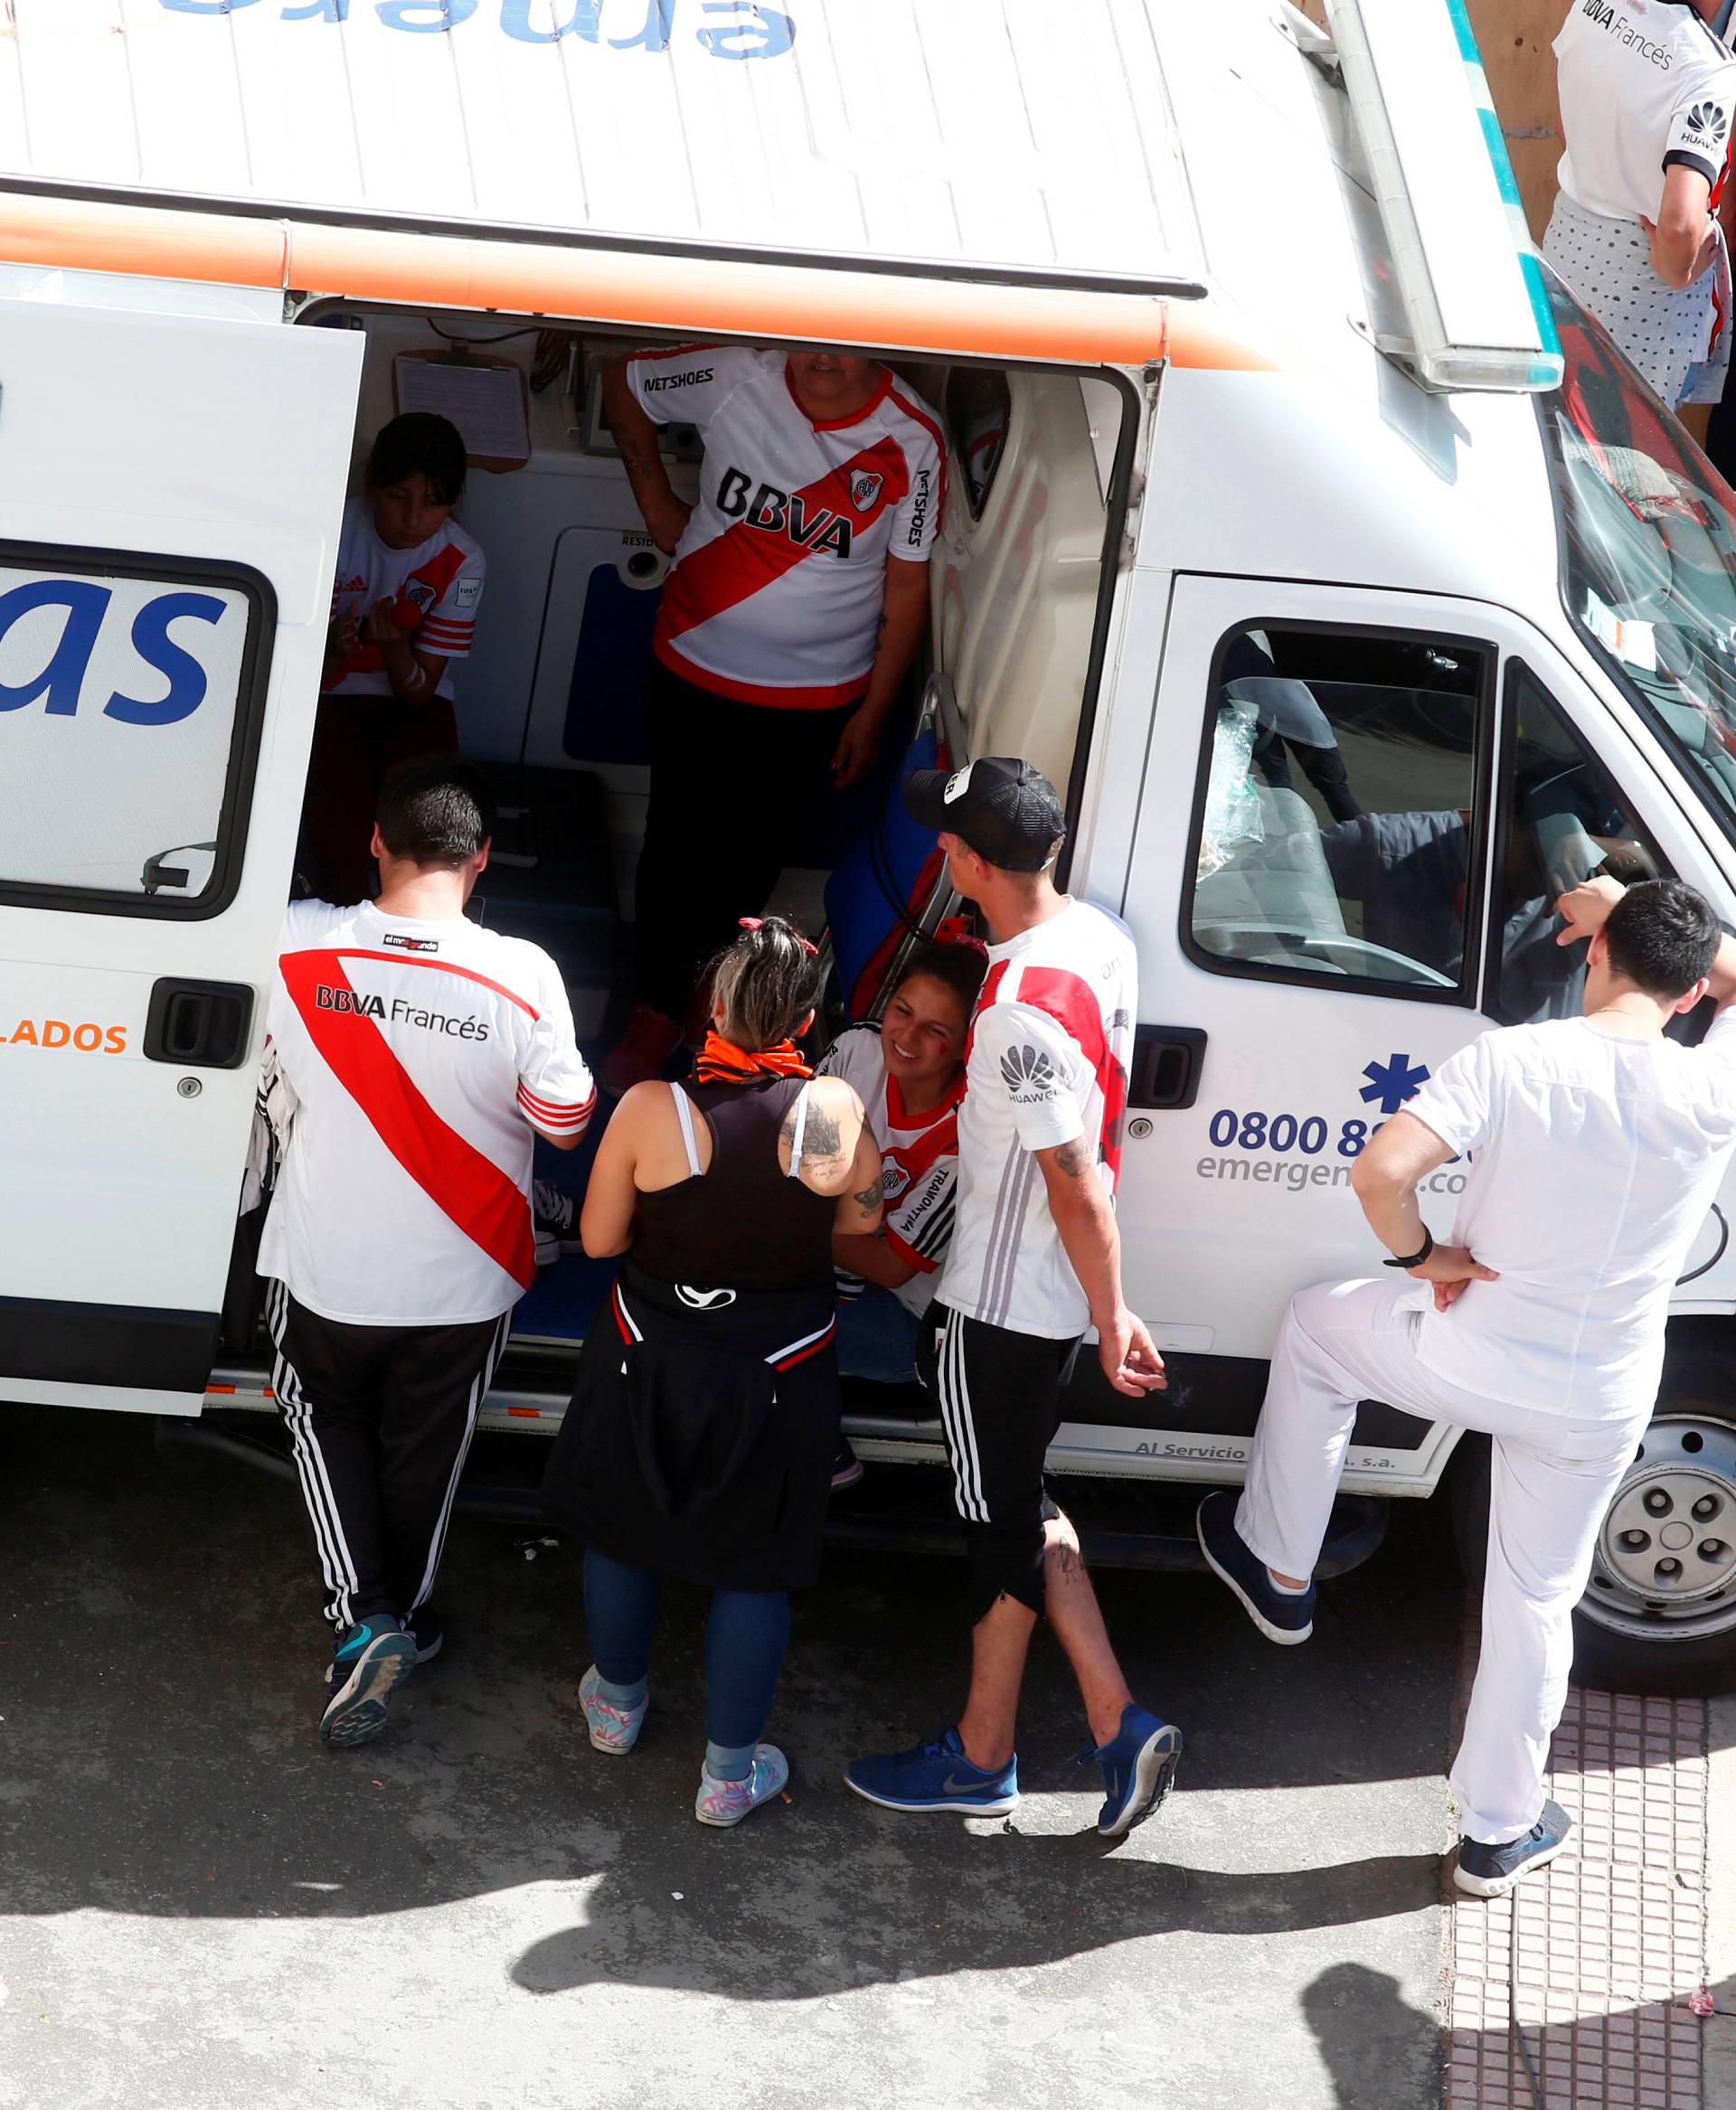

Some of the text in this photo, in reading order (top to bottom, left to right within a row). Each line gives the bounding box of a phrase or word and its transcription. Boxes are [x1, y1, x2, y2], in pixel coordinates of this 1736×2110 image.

[1610, 16, 1673, 71] Francés
[645, 368, 713, 391] NETSHOES
[716, 466, 853, 559] BBVA
[622, 537, 653, 547] RESID
[316, 985, 489, 1041] BBVA Francés
[1209, 1109, 1328, 1154] 0800
[1135, 1442, 1157, 1454] Al
[1163, 1444, 1245, 1459] Servicio
